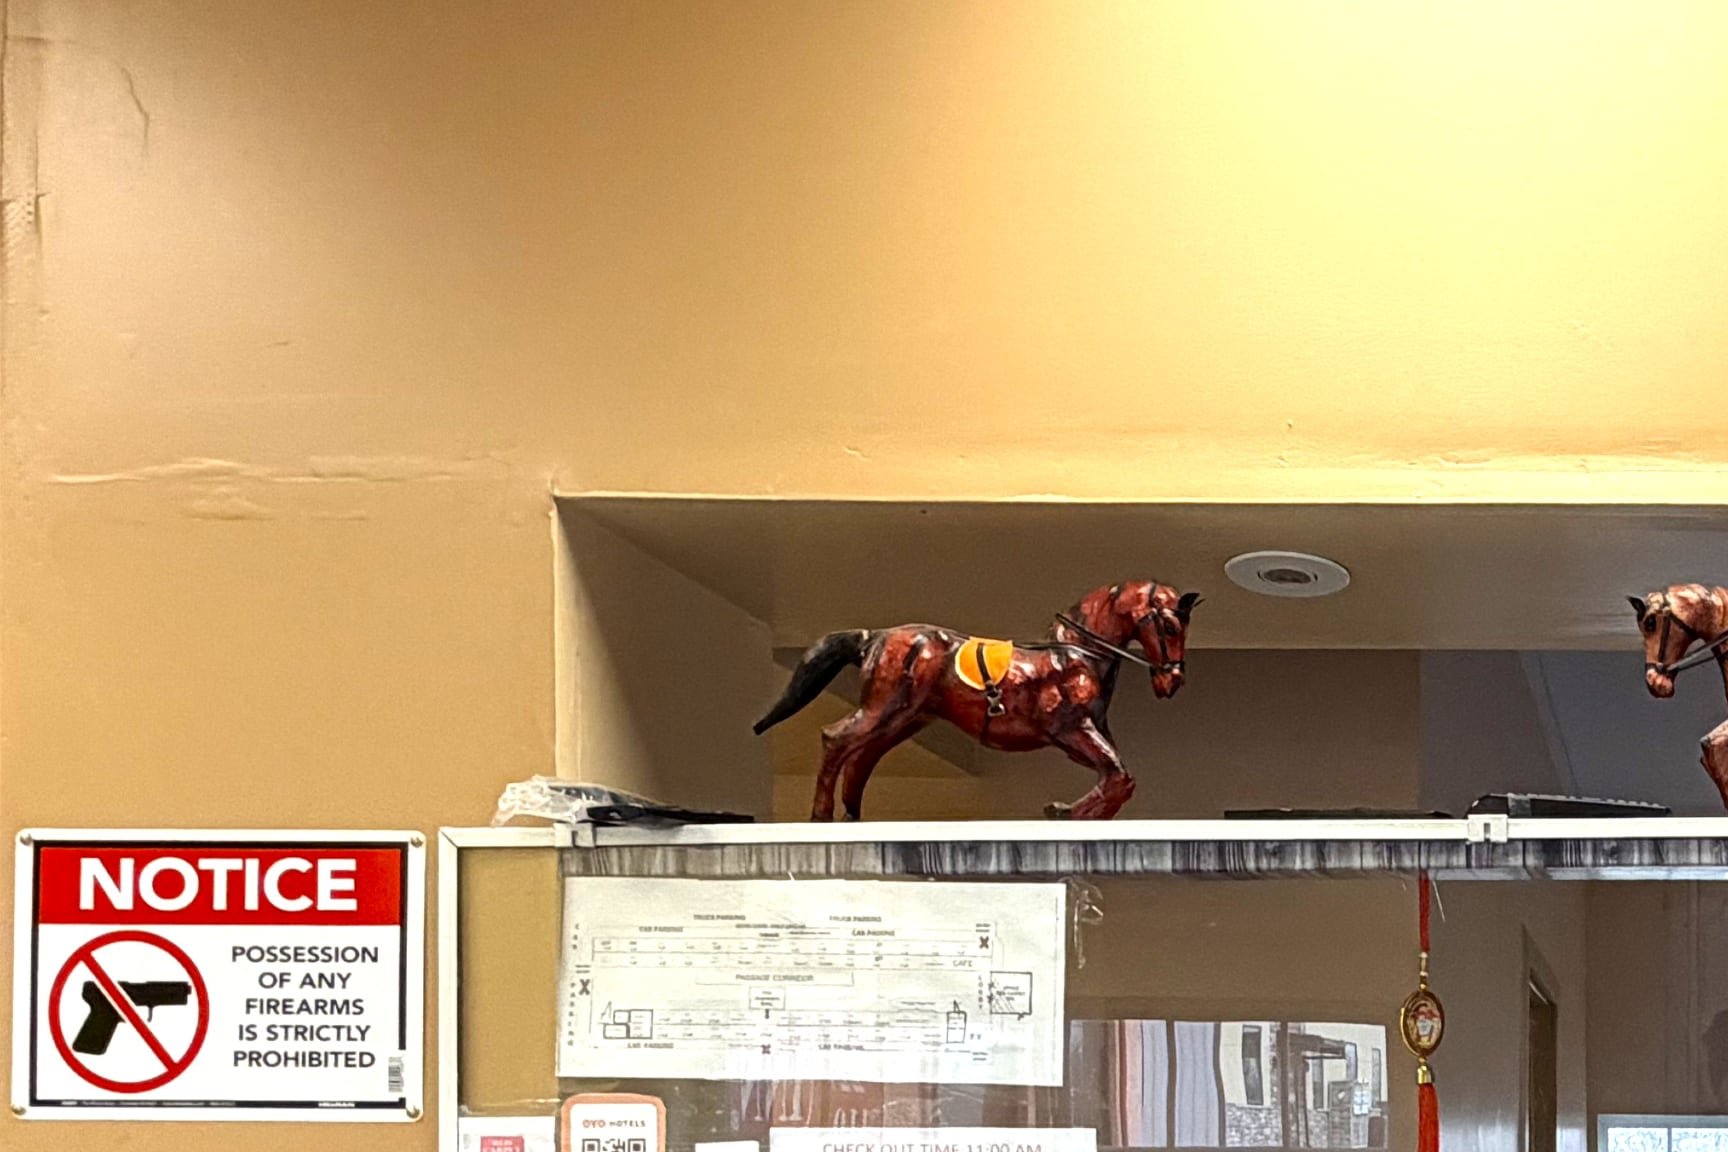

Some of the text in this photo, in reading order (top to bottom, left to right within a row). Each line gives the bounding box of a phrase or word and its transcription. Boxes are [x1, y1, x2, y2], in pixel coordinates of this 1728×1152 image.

[79, 856, 358, 912] NOTICE
[231, 945, 379, 964] POSSESSION
[258, 972, 352, 990] OF ANY
[244, 998, 365, 1016] FIREARMS
[238, 1024, 371, 1042] IS STRICTLY
[233, 1050, 376, 1069] PROHIBITED
[582, 1119, 646, 1128] OYO HOTELS
